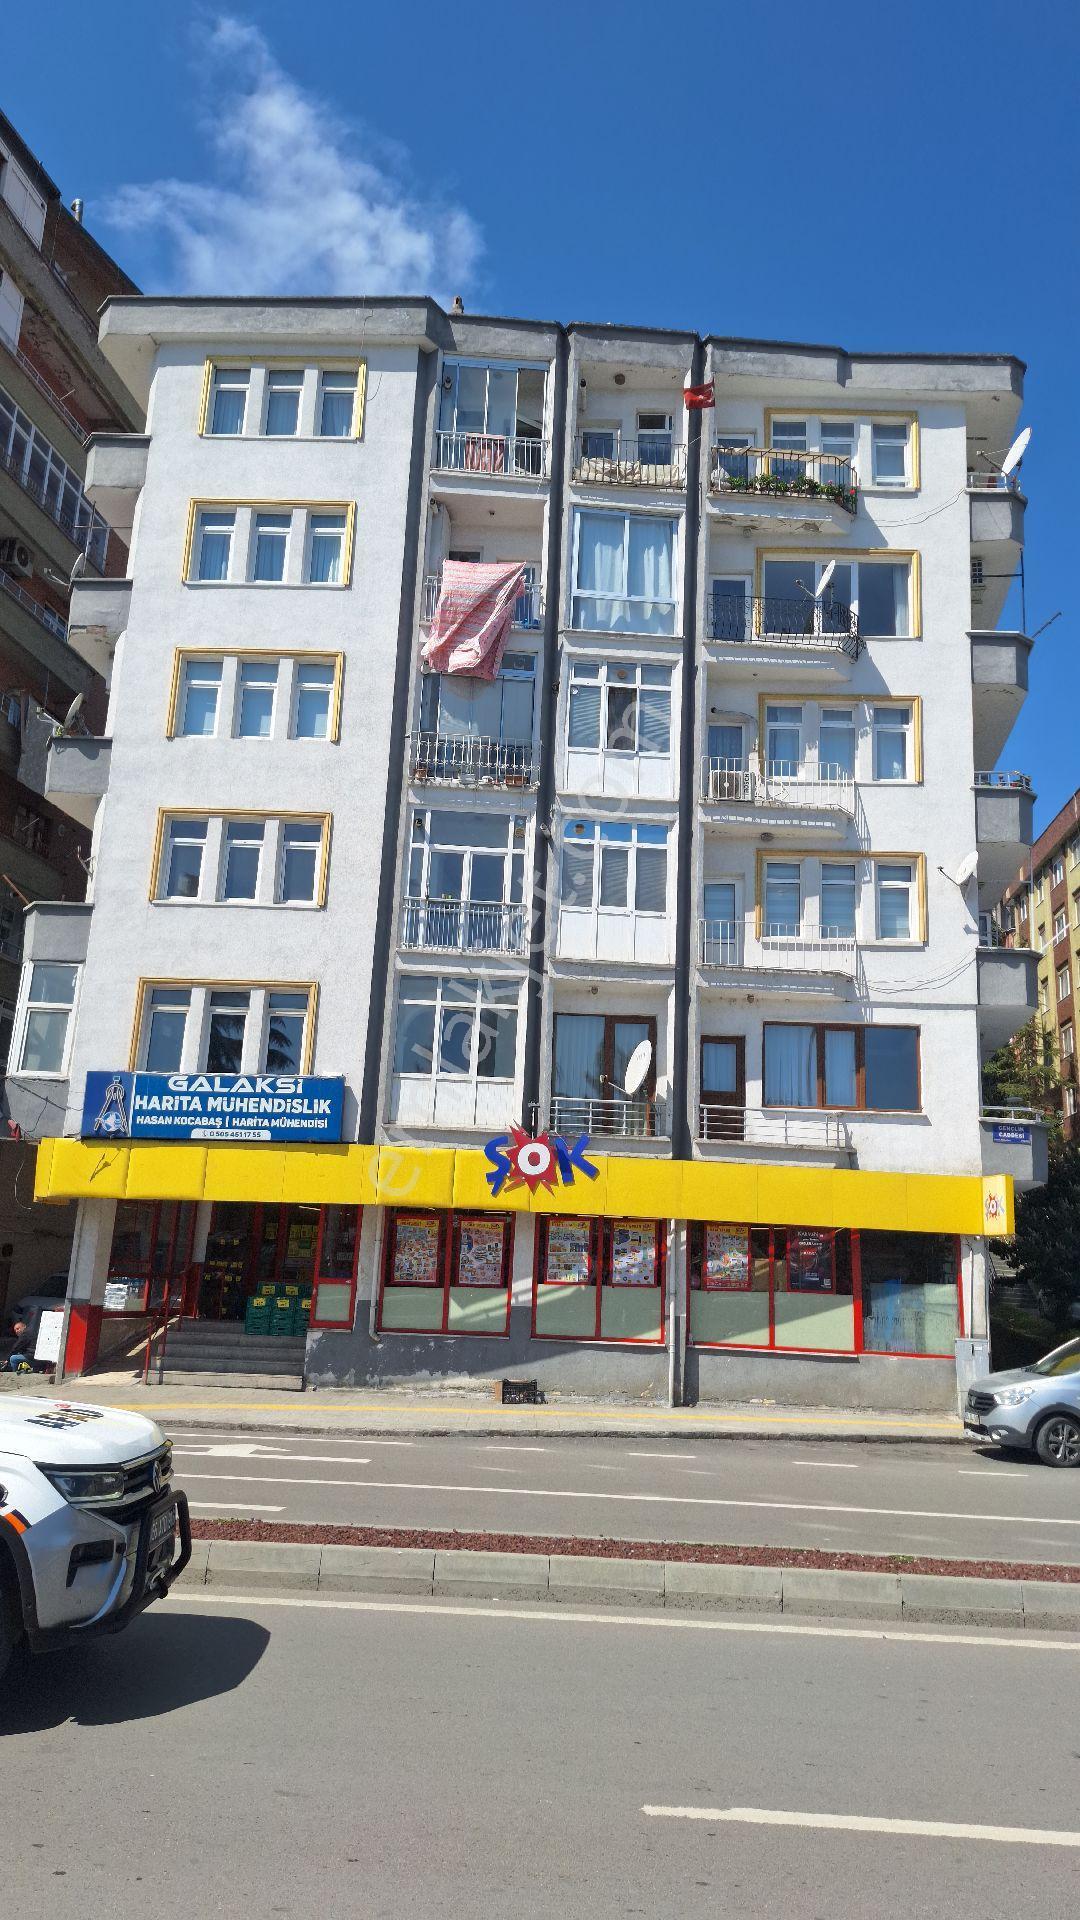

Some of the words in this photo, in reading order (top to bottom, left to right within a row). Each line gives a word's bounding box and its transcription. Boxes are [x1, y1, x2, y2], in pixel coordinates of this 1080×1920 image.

[136, 1115, 172, 1125] HASAN
[173, 1116, 223, 1128] KOCABAŞ
[232, 1116, 270, 1127] HARİTA
[270, 1116, 328, 1128] MÜHENDİSİ
[484, 1134, 600, 1197] ŞOK
